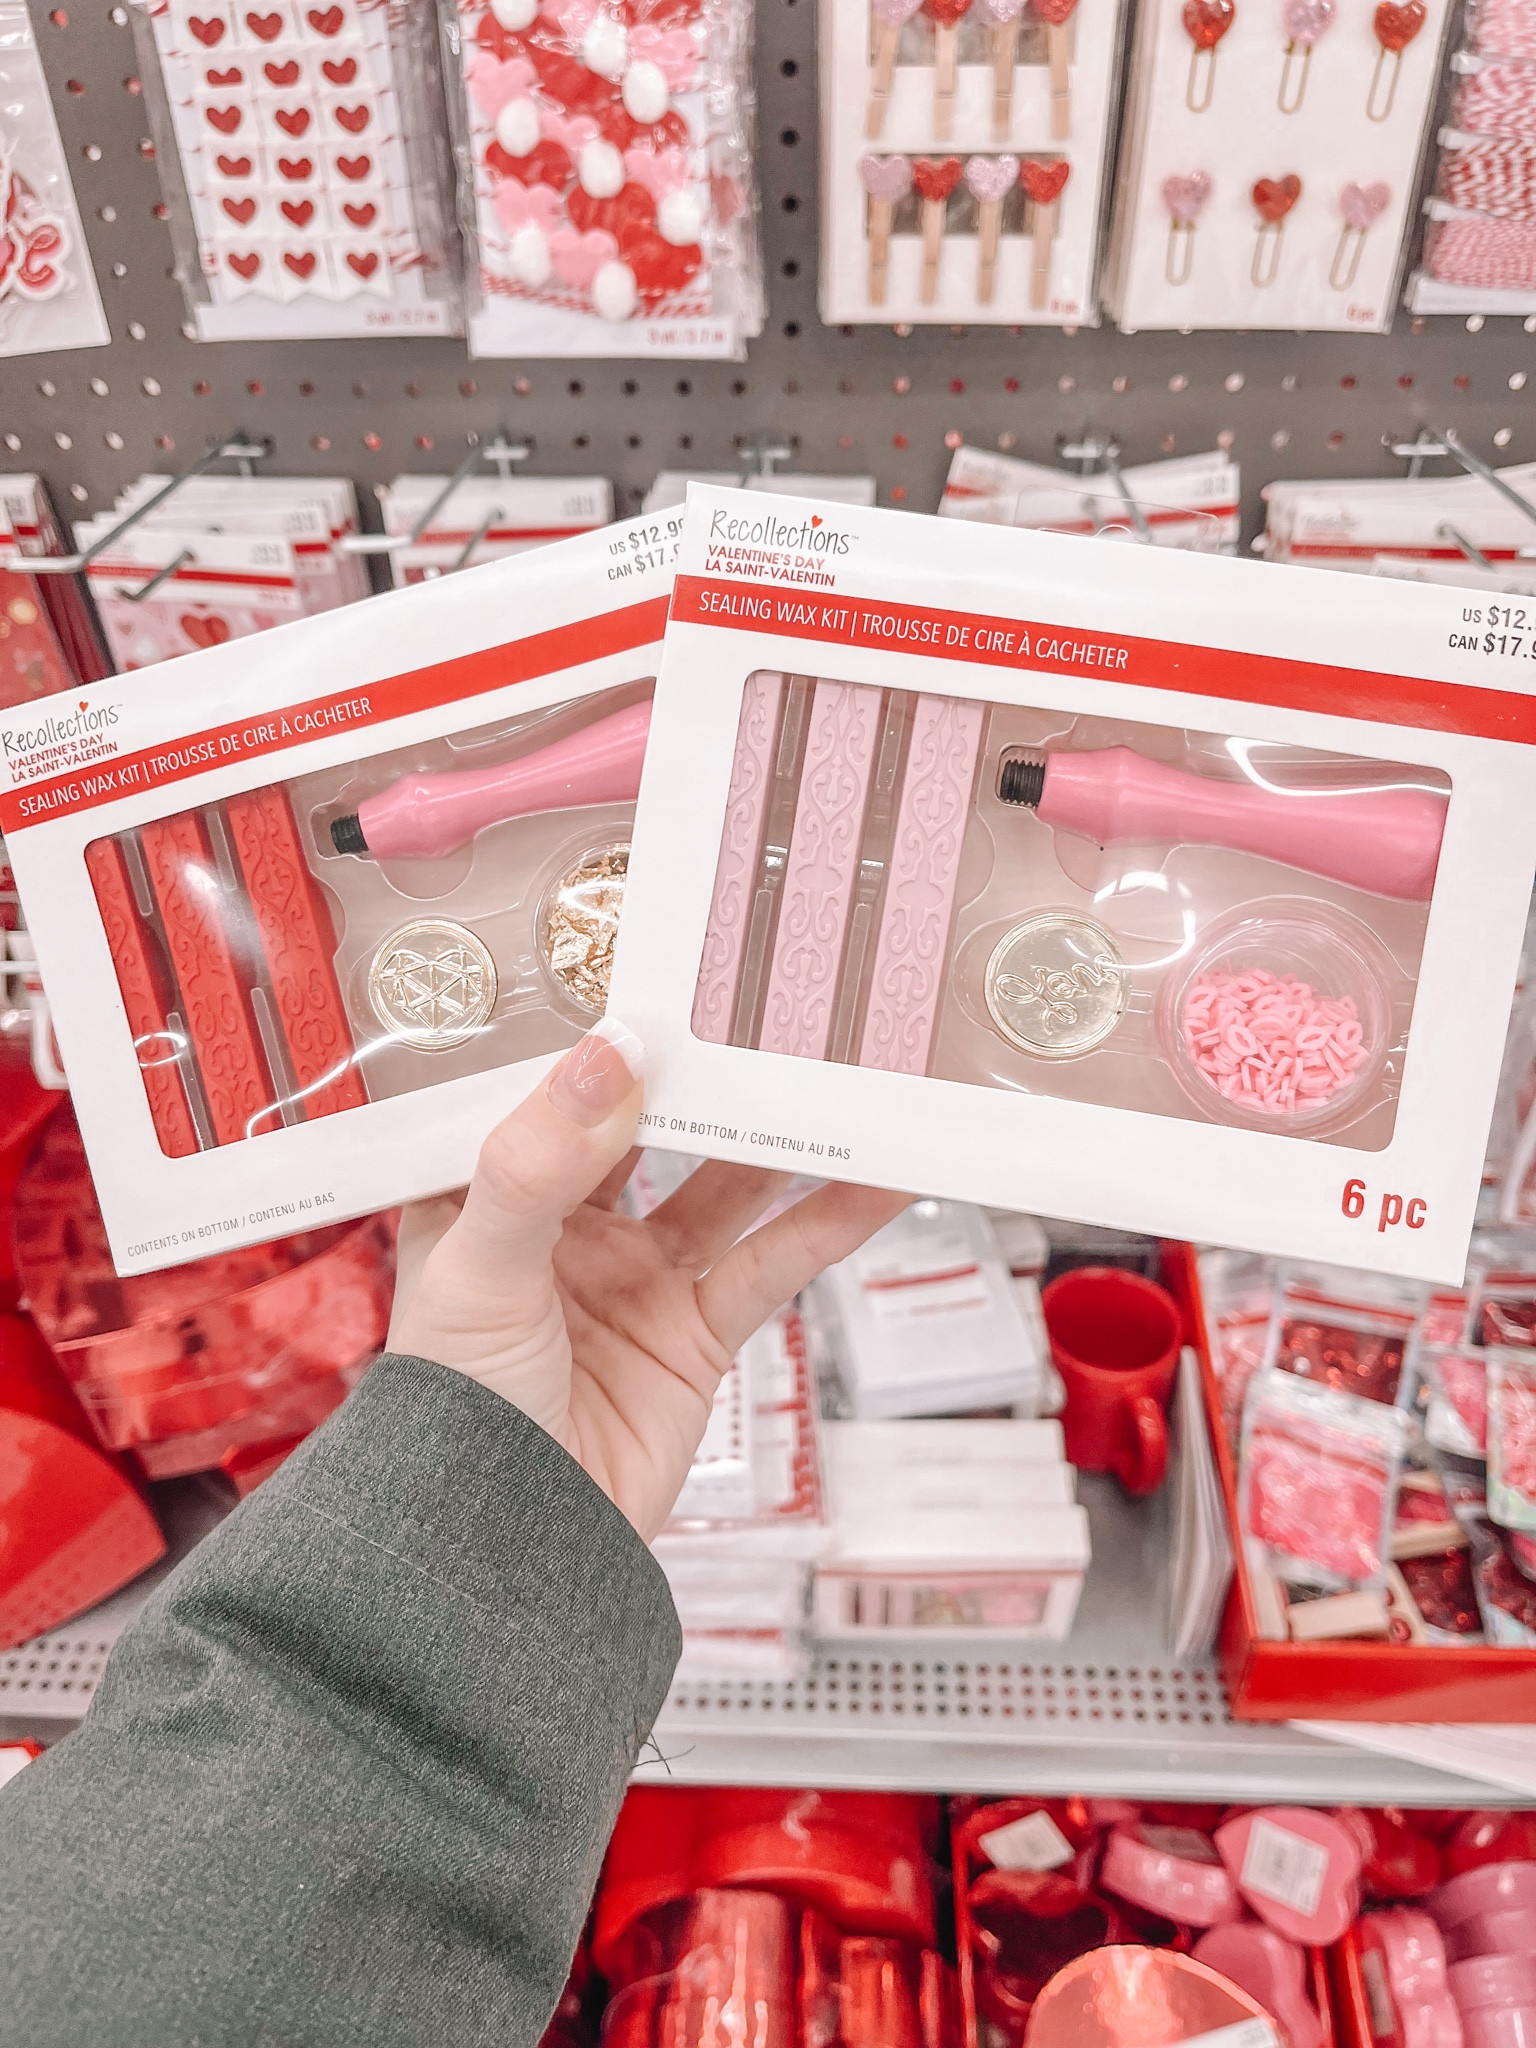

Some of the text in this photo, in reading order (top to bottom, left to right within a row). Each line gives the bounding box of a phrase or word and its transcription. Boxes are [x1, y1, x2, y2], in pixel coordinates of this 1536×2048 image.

[609, 541, 626, 556] US
[708, 544, 825, 571] VALENTINE'S DAY
[607, 563, 632, 581] CAN
[705, 558, 836, 587] LA SAINT-VALENTIN
[698, 590, 772, 620] SEALING
[777, 600, 818, 627] WAX
[821, 607, 849, 631] KIT
[862, 612, 942, 644] TROUSSE
[945, 624, 971, 648] DE
[974, 628, 1016, 654] CIRE
[1017, 630, 1031, 656] À
[1035, 637, 1130, 670] CACHETER
[1462, 604, 1536, 632] US $12.
[1448, 633, 1478, 651] CAN
[8, 732, 104, 771] VALENTINE'S DAY
[11, 740, 118, 784] LA SAINT-VALENTIN
[19, 783, 81, 817] SEALING
[80, 771, 118, 797] WAX
[118, 763, 140, 786] KIT
[149, 740, 218, 776] TROUSSE
[219, 733, 241, 755] DE
[243, 723, 278, 748] CIRE
[281, 716, 293, 737] À
[294, 697, 372, 733] CACHETER
[670, 1118, 686, 1132] ON
[690, 1122, 738, 1140] BOTTOM
[750, 1132, 804, 1152] CONTENU
[808, 1142, 824, 1156] AU
[828, 1145, 851, 1160] BAS
[127, 1234, 178, 1257] CONTENTS
[181, 1229, 196, 1243] ON
[198, 1217, 239, 1239] BOTTOM
[248, 1203, 296, 1224] CONTENU
[299, 1198, 313, 1210] AU
[315, 1191, 335, 1206] BAS
[1341, 1178, 1427, 1233] 6 pc
